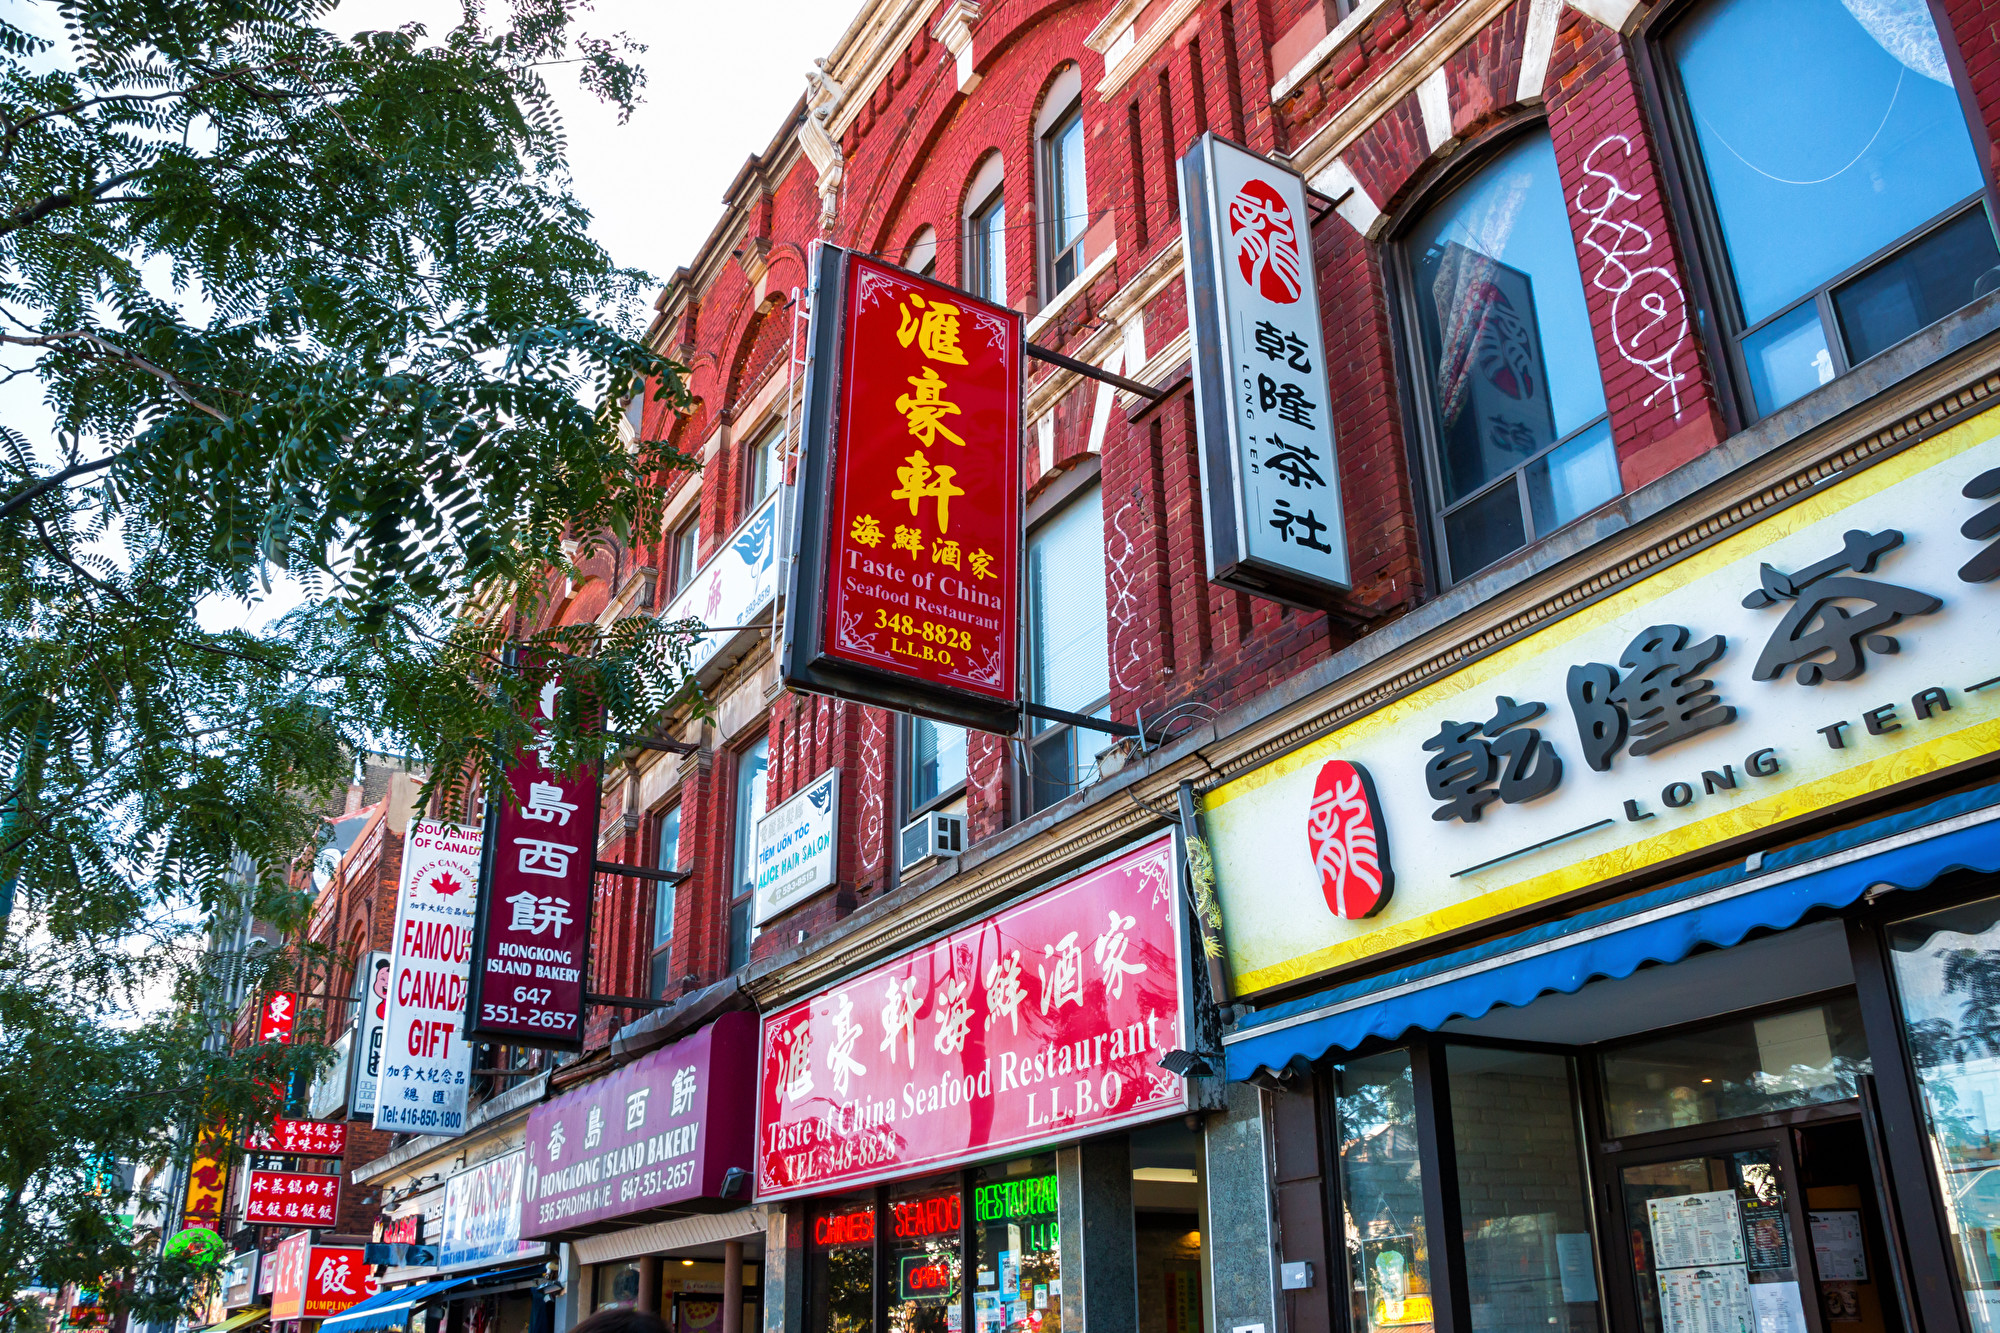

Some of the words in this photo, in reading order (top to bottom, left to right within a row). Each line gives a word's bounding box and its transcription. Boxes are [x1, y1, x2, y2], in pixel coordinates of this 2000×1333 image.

[1242, 364, 1255, 420] LONG
[1248, 434, 1260, 475] TEA
[1255, 320, 1332, 554] 乾隆茶社
[850, 514, 998, 580] 海鮮酒家
[845, 548, 906, 582] Taste
[912, 572, 935, 591] of
[939, 576, 1001, 610] China
[846, 576, 909, 606] Seafood
[915, 595, 999, 631] Restaurant
[874, 609, 972, 652] 348-8828
[891, 637, 955, 667] L.L.B.O.
[1623, 747, 1781, 823] LONG
[1816, 686, 1953, 751] TEA
[415, 838, 431, 848] OF
[758, 865, 779, 891] ALICE
[781, 851, 800, 876] HAIR
[802, 831, 830, 864] SALON
[410, 862, 436, 898] FAMOUS
[410, 902, 474, 918] 加拿大紀念品
[487, 958, 532, 977] ISLAND
[535, 964, 580, 983] BAKERY
[499, 942, 572, 965] HONGKONG
[482, 1003, 577, 1030] 351-2657
[513, 986, 552, 1005] 647
[408, 1018, 455, 1059] GIFT
[386, 1064, 465, 1085] 加拿大紀念品
[768, 1119, 812, 1153] Taste
[816, 1100, 838, 1140] of
[837, 1094, 896, 1135] China
[901, 1059, 991, 1119] Seafood
[998, 1008, 1160, 1093] Restaurant
[382, 1105, 398, 1123] Tel:
[400, 1107, 462, 1129] 416-850-1800
[547, 1064, 697, 1162] 香島西餅
[1025, 1071, 1122, 1128] L.L.B.O
[540, 1157, 600, 1199] HONGKONG
[602, 1142, 644, 1179] ISLAND
[647, 1122, 699, 1166] BAKERY
[786, 1152, 822, 1182] TEL:
[826, 1130, 896, 1176] 348-8828
[538, 1202, 556, 1224] 336
[556, 1189, 591, 1220] SPADINA
[593, 1182, 613, 1209] AVE.
[620, 1159, 696, 1203] 647-351-2657
